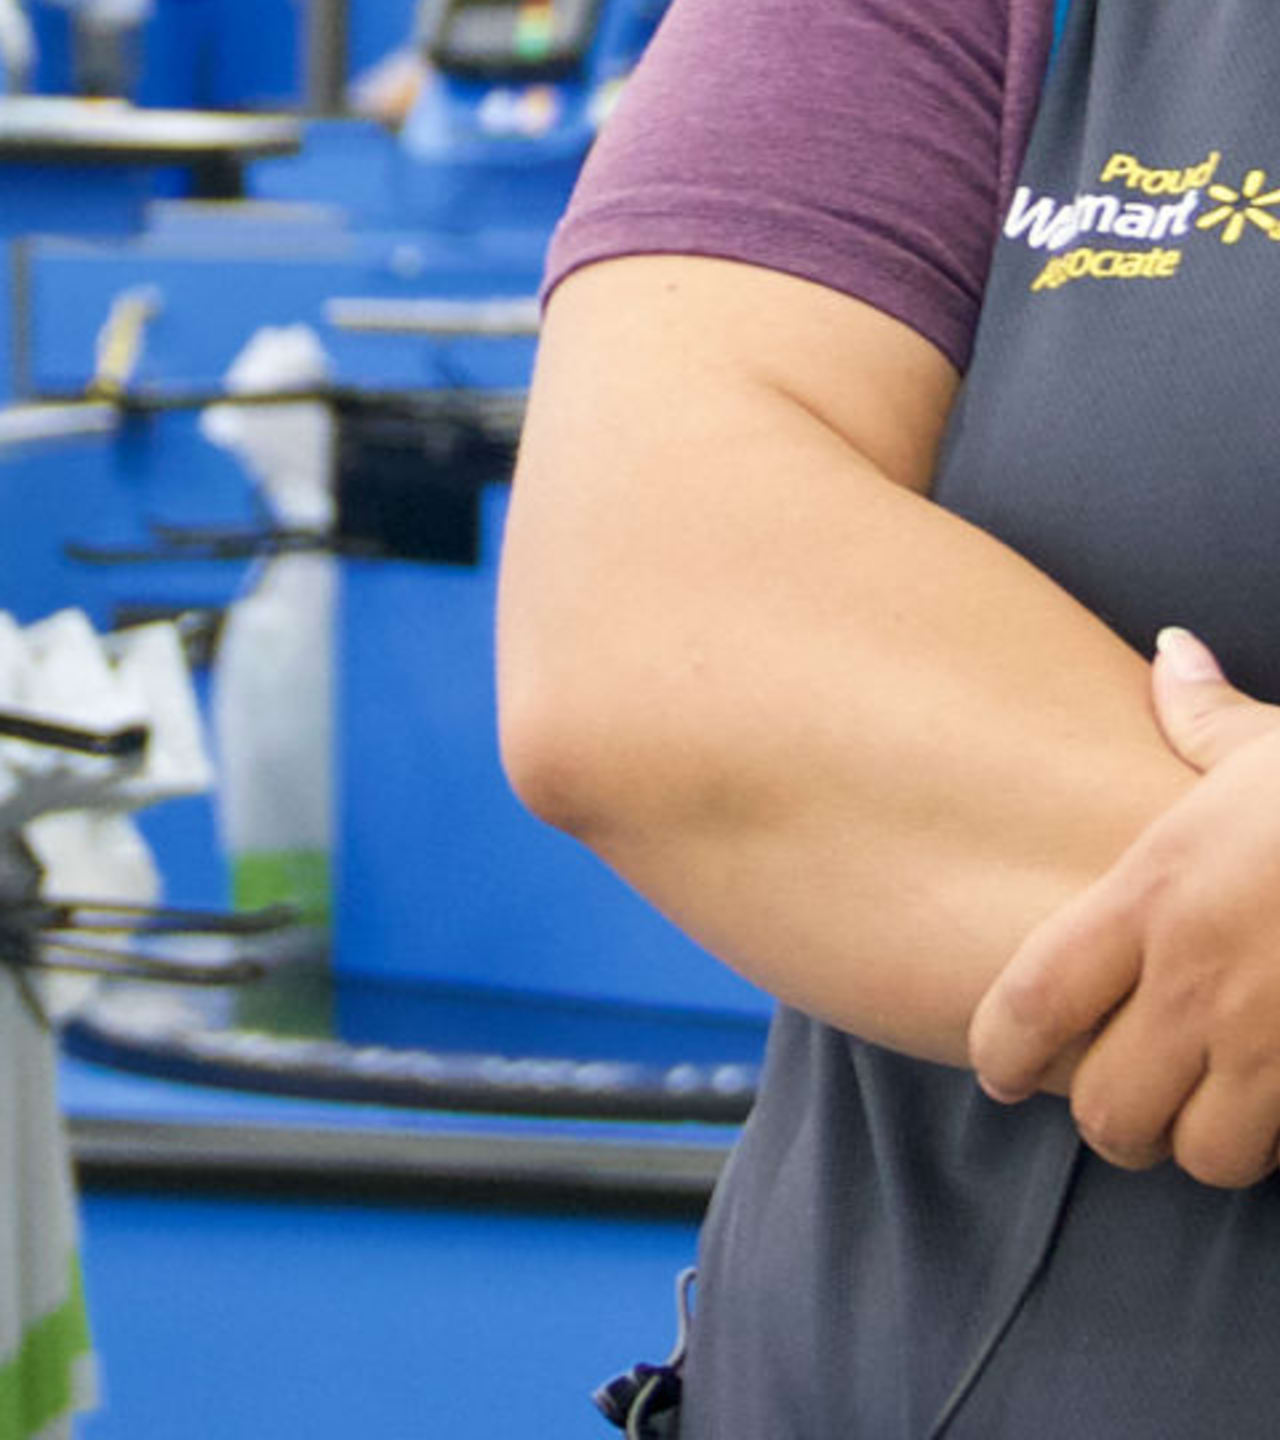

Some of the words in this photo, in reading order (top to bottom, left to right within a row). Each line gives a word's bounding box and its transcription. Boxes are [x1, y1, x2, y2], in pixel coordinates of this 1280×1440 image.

[1100, 151, 1221, 195] Proud
[1003, 185, 1199, 251] Wmart
[1031, 247, 1182, 292] Aociate
